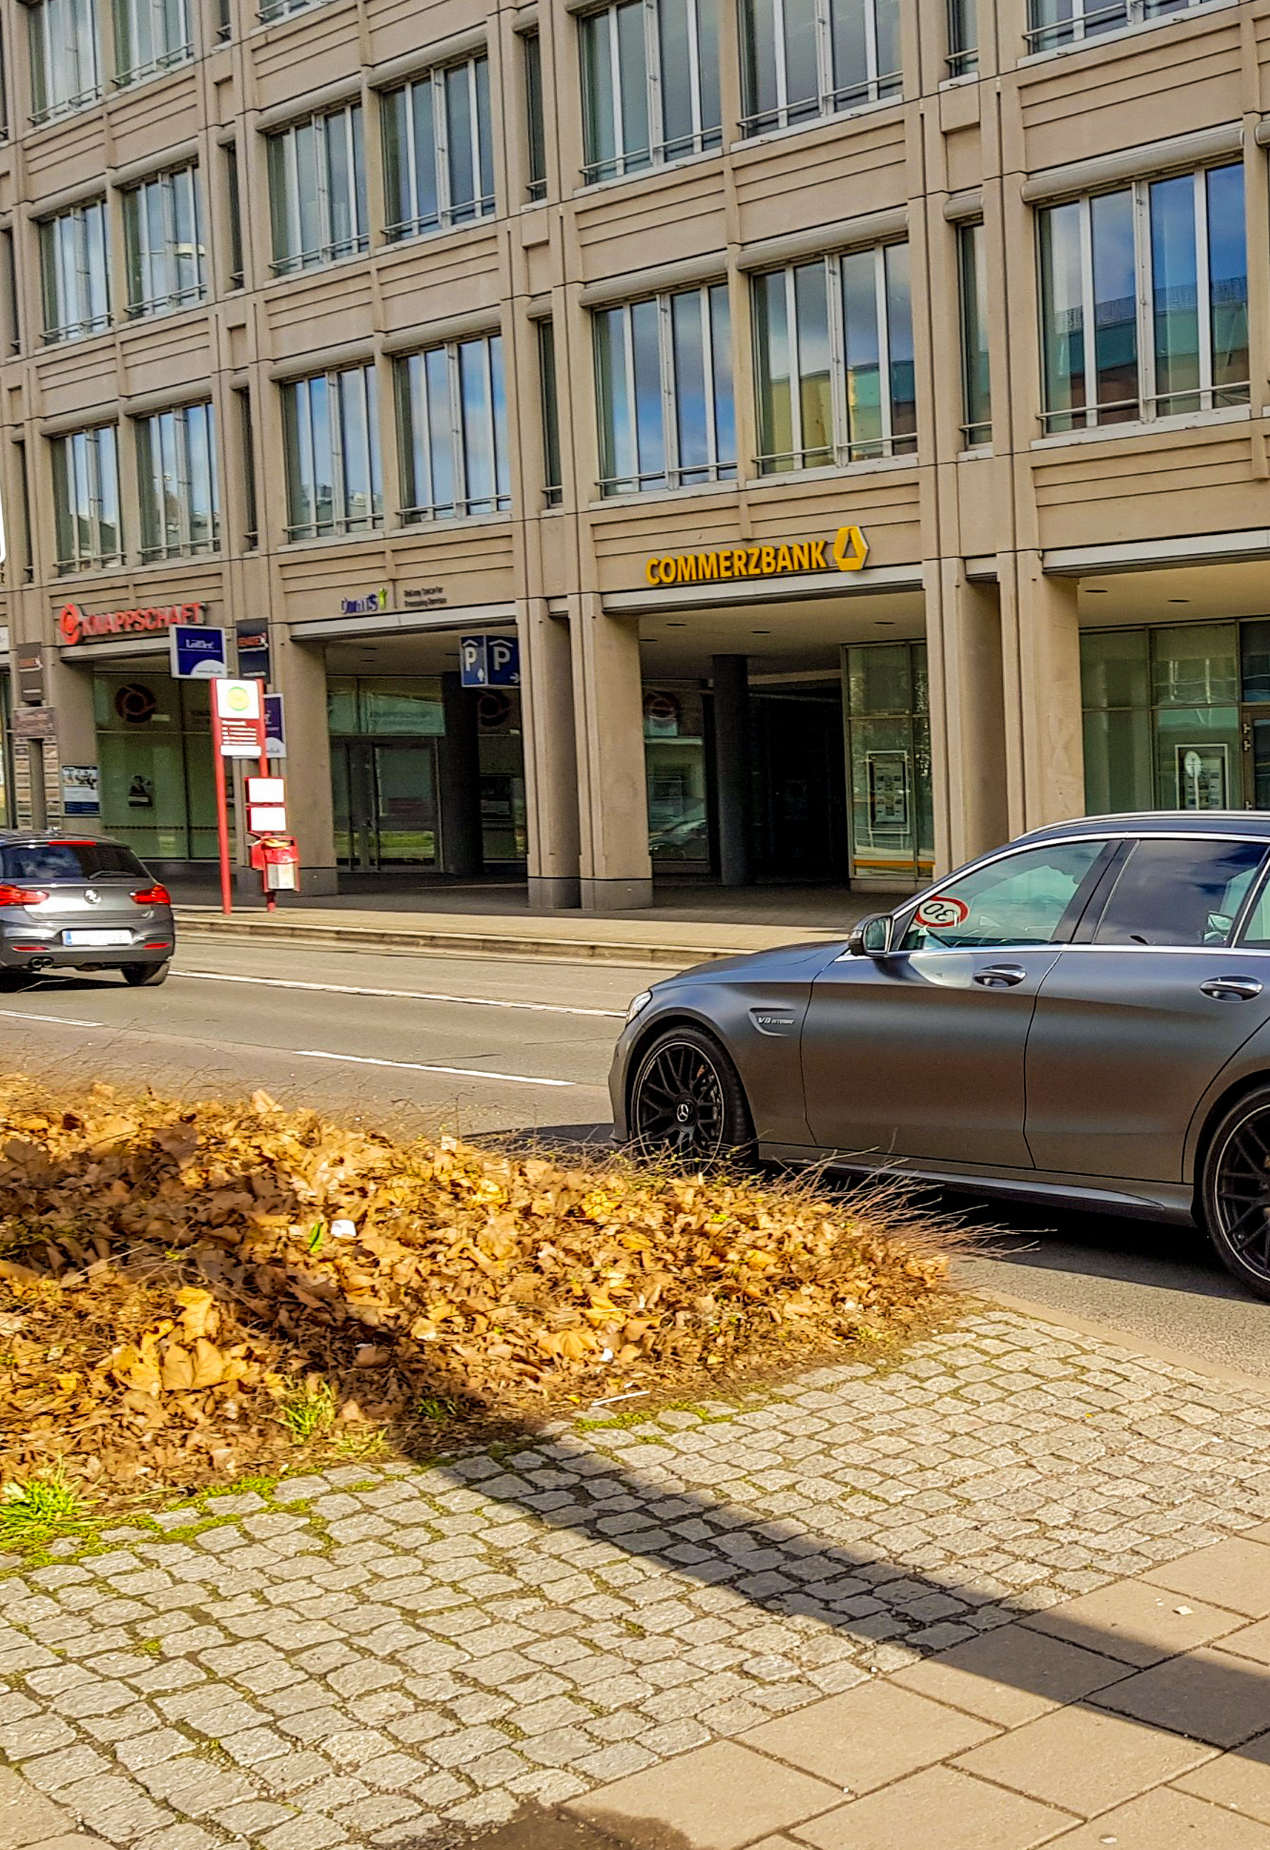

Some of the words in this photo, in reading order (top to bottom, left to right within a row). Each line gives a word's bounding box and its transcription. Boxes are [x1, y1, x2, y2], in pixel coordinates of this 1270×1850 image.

[645, 540, 829, 585] COMMERZBANK
[81, 602, 205, 636] KNAPPSCHAFT
[464, 647, 478, 672] P
[492, 646, 512, 671] P
